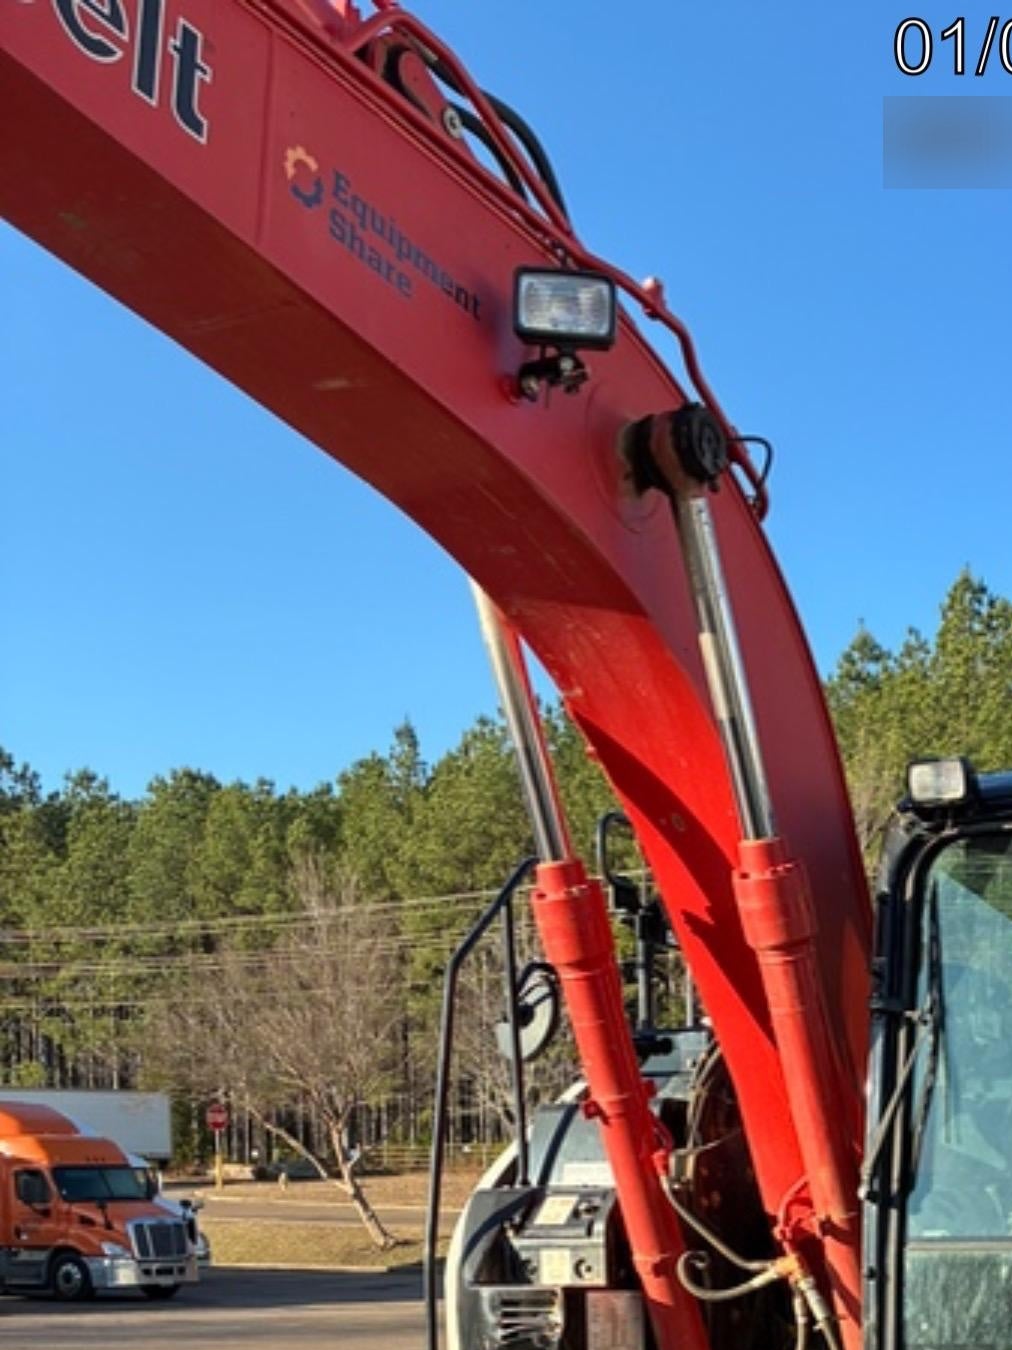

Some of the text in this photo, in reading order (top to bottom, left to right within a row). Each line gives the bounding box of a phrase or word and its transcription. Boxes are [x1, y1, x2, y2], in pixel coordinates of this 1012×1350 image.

[50, 0, 213, 145] elt
[328, 206, 413, 299] Share
[331, 166, 481, 322] Equipment
